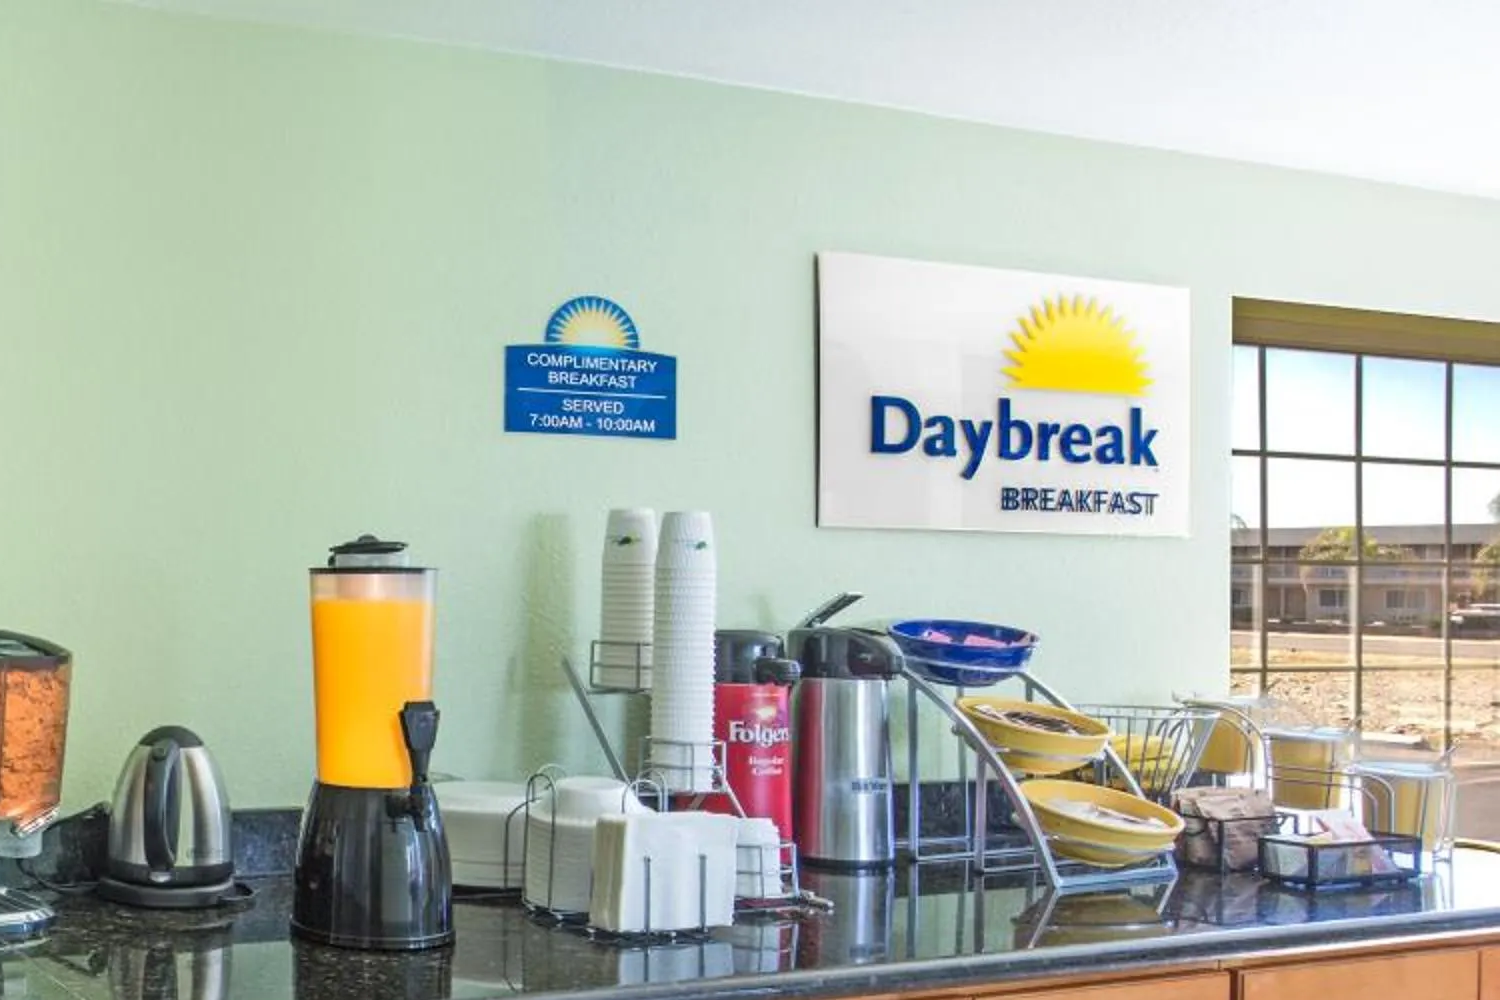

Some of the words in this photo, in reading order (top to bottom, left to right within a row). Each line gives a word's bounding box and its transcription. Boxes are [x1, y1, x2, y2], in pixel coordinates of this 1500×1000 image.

[527, 353, 658, 373] COMPLIMENTARY
[548, 371, 638, 389] BREAKFAST
[562, 399, 625, 415] SERVED
[529, 413, 583, 429] 7:00AM
[597, 418, 656, 432] 10:00AM
[870, 395, 1159, 481] Daybreak
[1000, 487, 1159, 516] BREAKFAST
